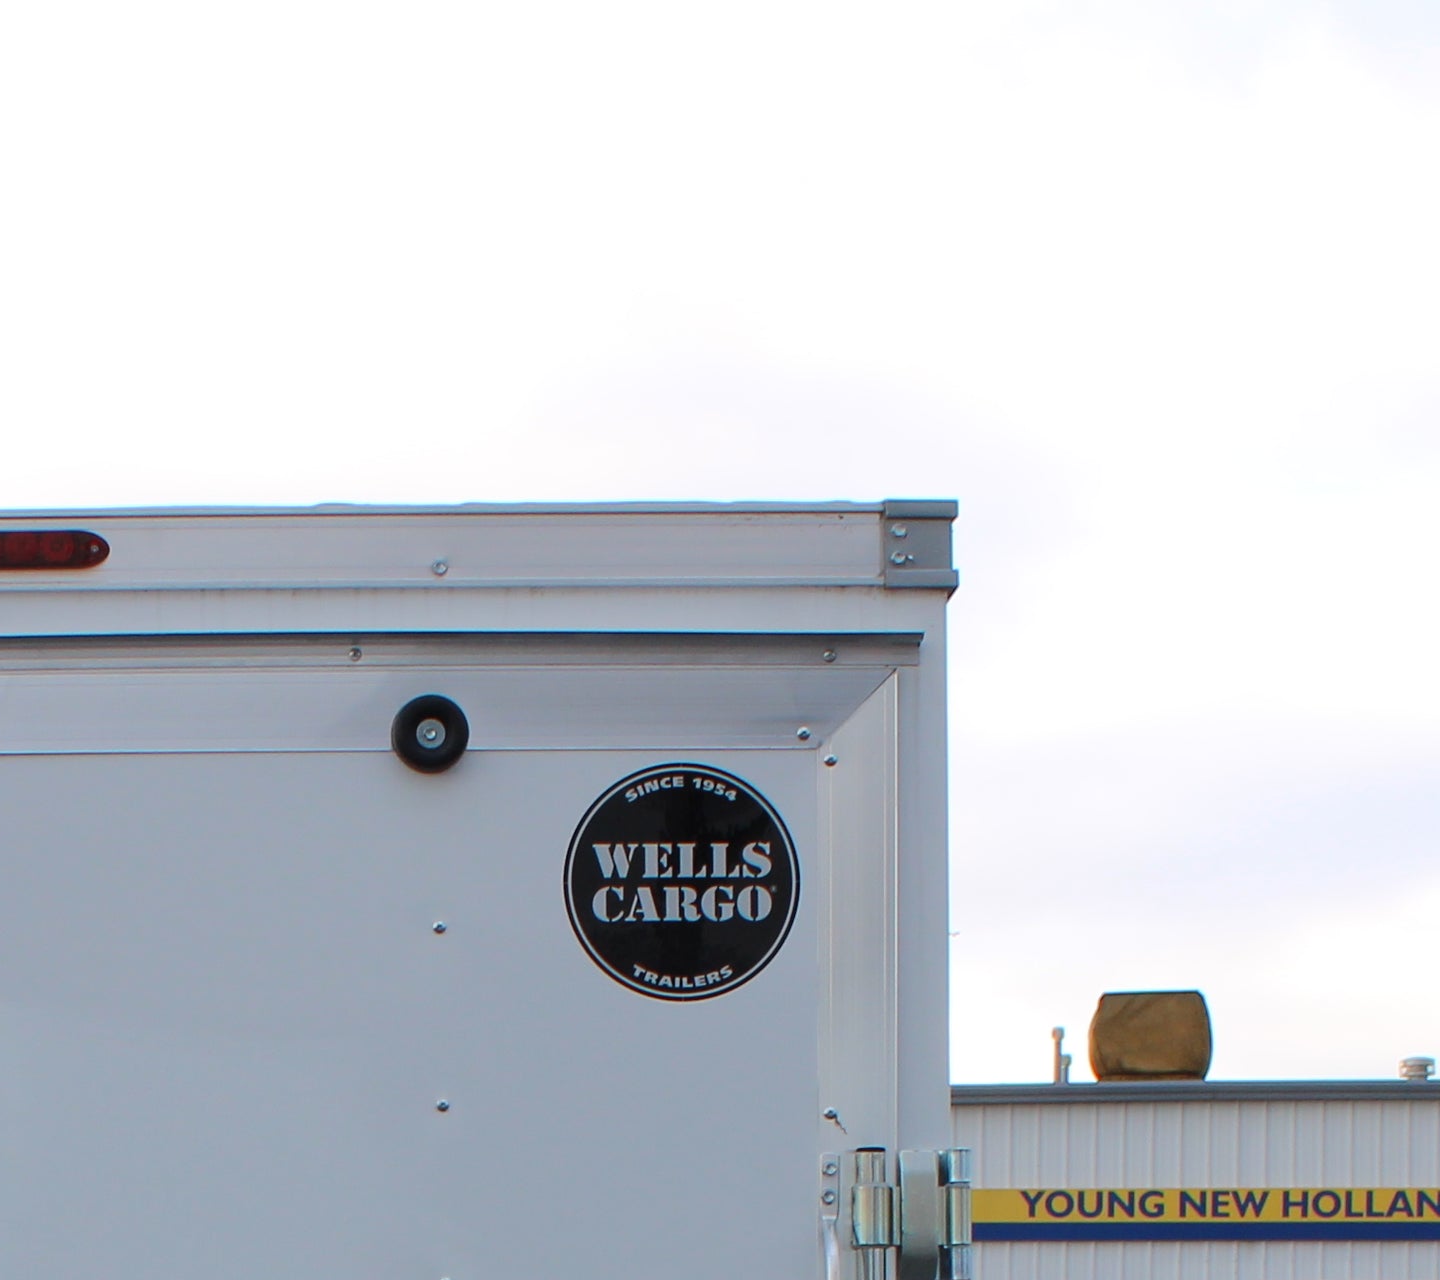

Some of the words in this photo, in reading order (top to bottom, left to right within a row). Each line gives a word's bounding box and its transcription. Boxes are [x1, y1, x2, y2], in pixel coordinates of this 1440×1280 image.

[624, 776, 685, 803] SINCE
[692, 777, 738, 803] 1954
[592, 841, 772, 879] WELLS
[591, 885, 773, 923] CARGO
[632, 963, 734, 989] TRAILERS
[1019, 1190, 1166, 1219] YOUNG
[1178, 1190, 1270, 1218] NEW
